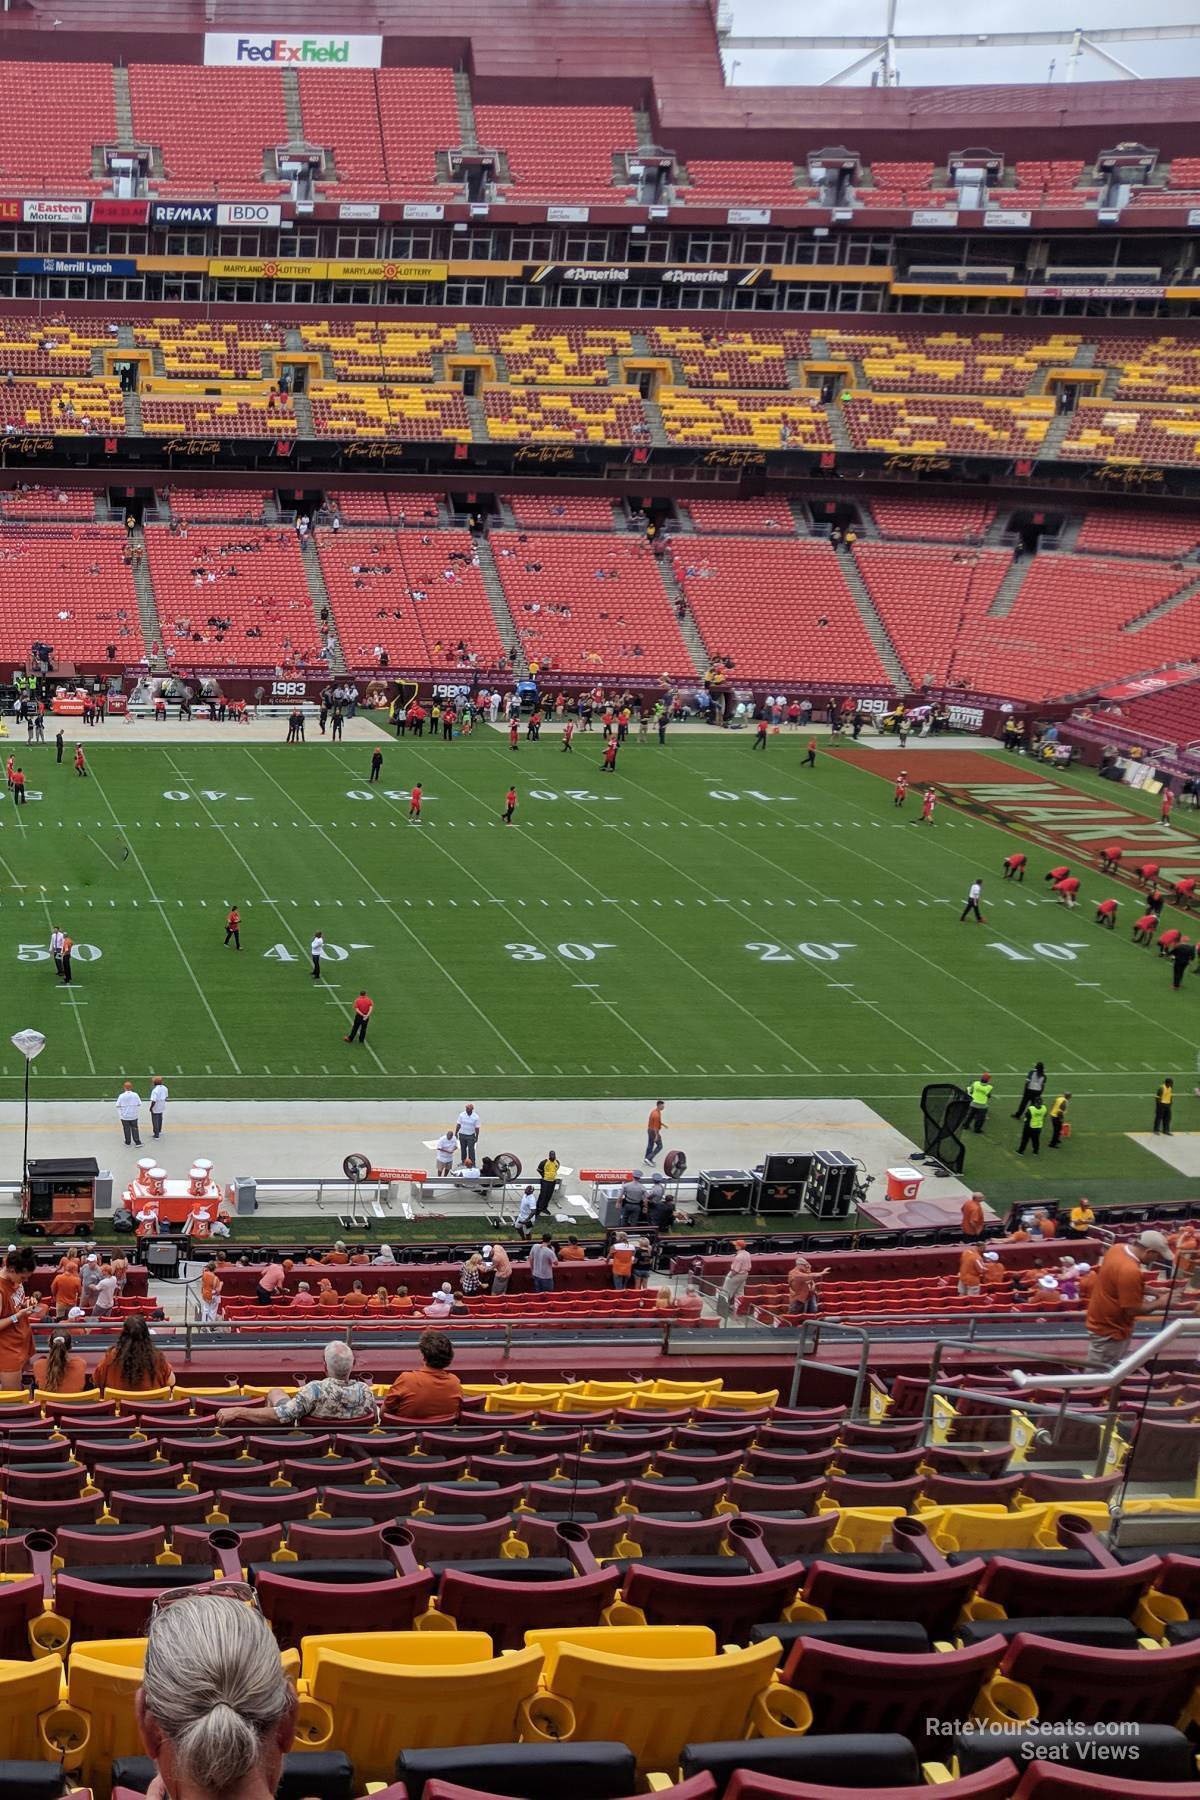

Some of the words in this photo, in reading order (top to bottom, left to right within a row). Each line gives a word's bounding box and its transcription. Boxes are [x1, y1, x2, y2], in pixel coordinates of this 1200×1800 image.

[237, 39, 349, 62] FedExField
[38, 203, 82, 214] Eastern
[156, 207, 212, 221] RE/MAX
[234, 206, 269, 220] BDO
[56, 261, 84, 272] Merrill
[86, 262, 112, 274] Lynch
[224, 264, 262, 273] MARYLAND
[280, 266, 312, 274] LOTTERY
[343, 267, 382, 275] MARYLAND
[400, 268, 432, 276] LOTTERY
[575, 268, 629, 280] Ameritel
[672, 270, 728, 282] Ameritel
[271, 682, 306, 696] 1983
[856, 700, 889, 713] 1991
[16, 943, 103, 963] 50
[504, 942, 599, 962] 30
[745, 942, 842, 962] 20
[986, 942, 1074, 962] 10
[379, 1172, 413, 1180] GATORADE
[594, 1173, 629, 1181] GATORADE
[154, 1180, 163, 1191] G
[196, 1180, 204, 1191] G
[904, 1184, 917, 1198] G
[144, 1220, 152, 1232] G
[198, 1220, 208, 1232] G
